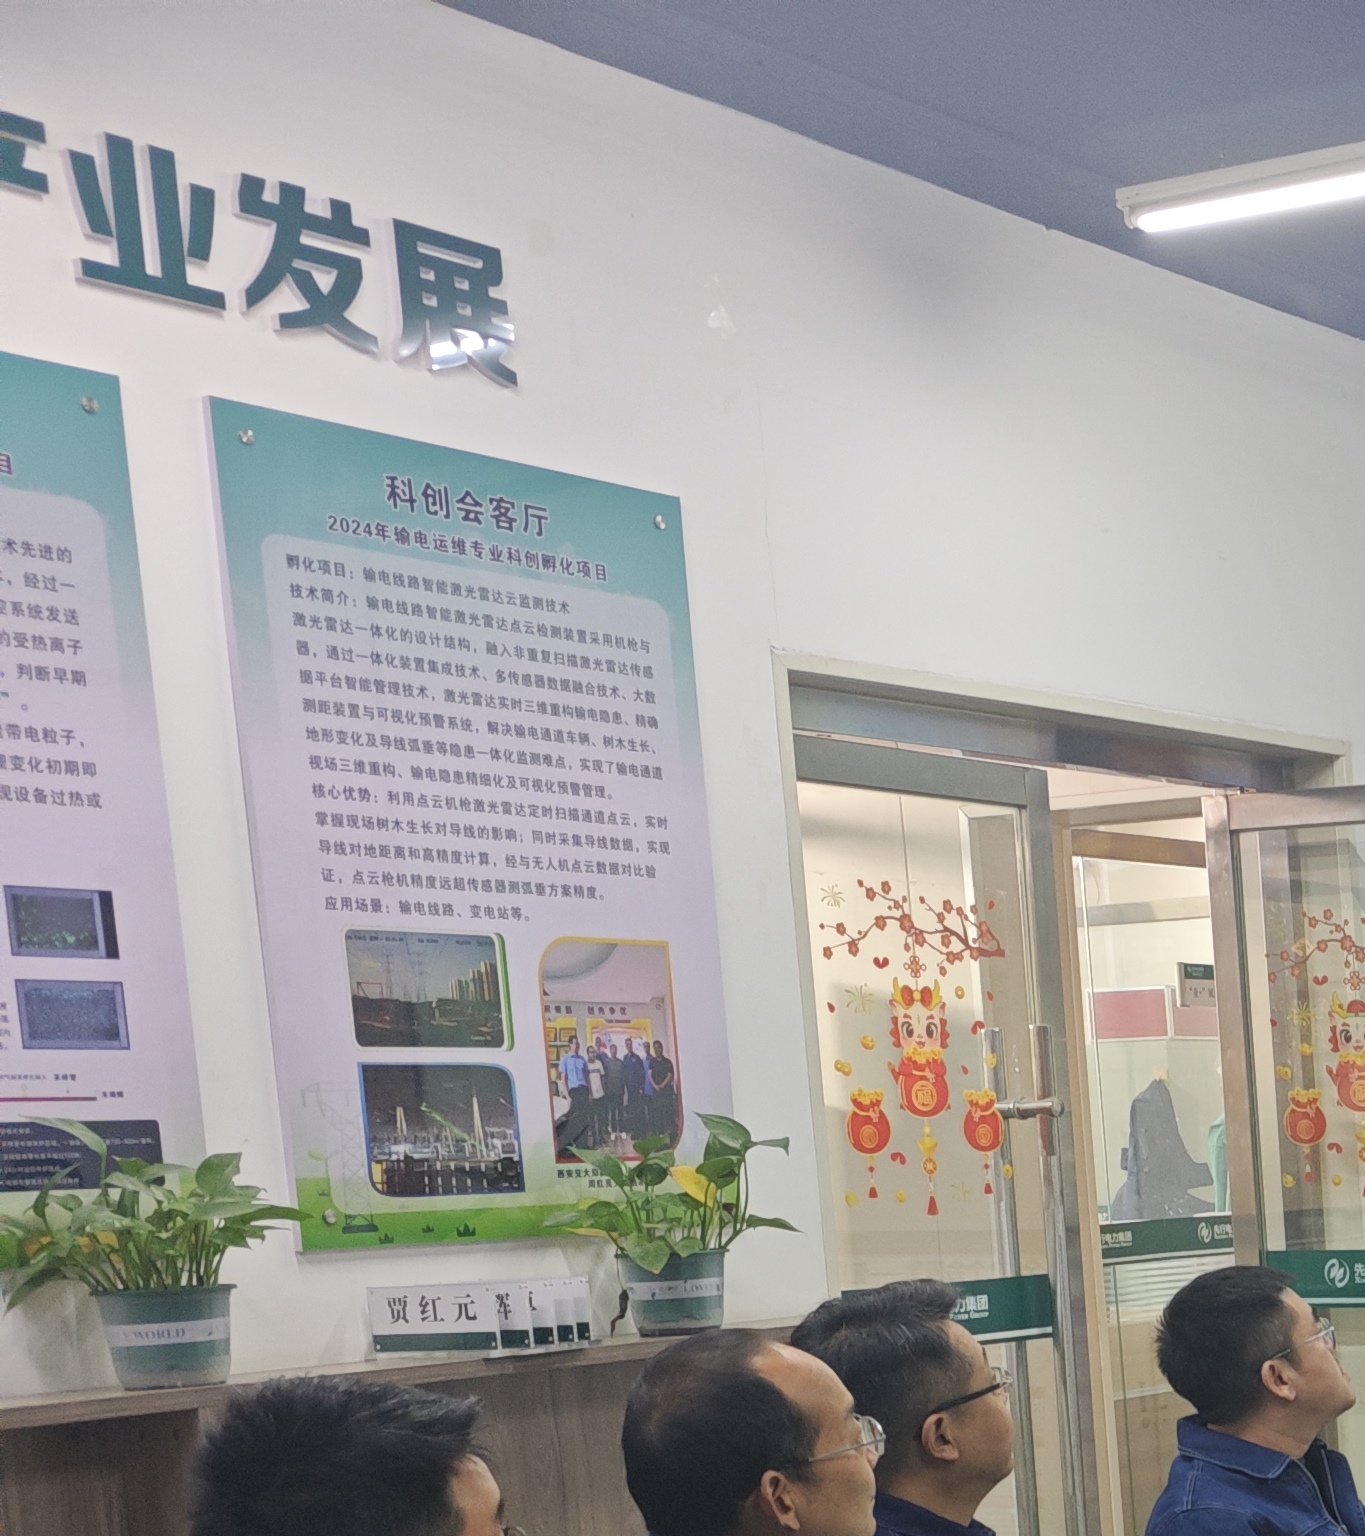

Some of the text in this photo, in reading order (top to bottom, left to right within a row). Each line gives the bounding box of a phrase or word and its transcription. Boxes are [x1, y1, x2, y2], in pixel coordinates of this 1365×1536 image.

[384, 475, 549, 538] 科创会客厅
[327, 515, 608, 583] 2024年输电运维专业科创孵化项目
[0, 572, 76, 593] ，经过一
[0, 722, 86, 748] 带电粒子，
[386, 1293, 478, 1324] 贾红元
